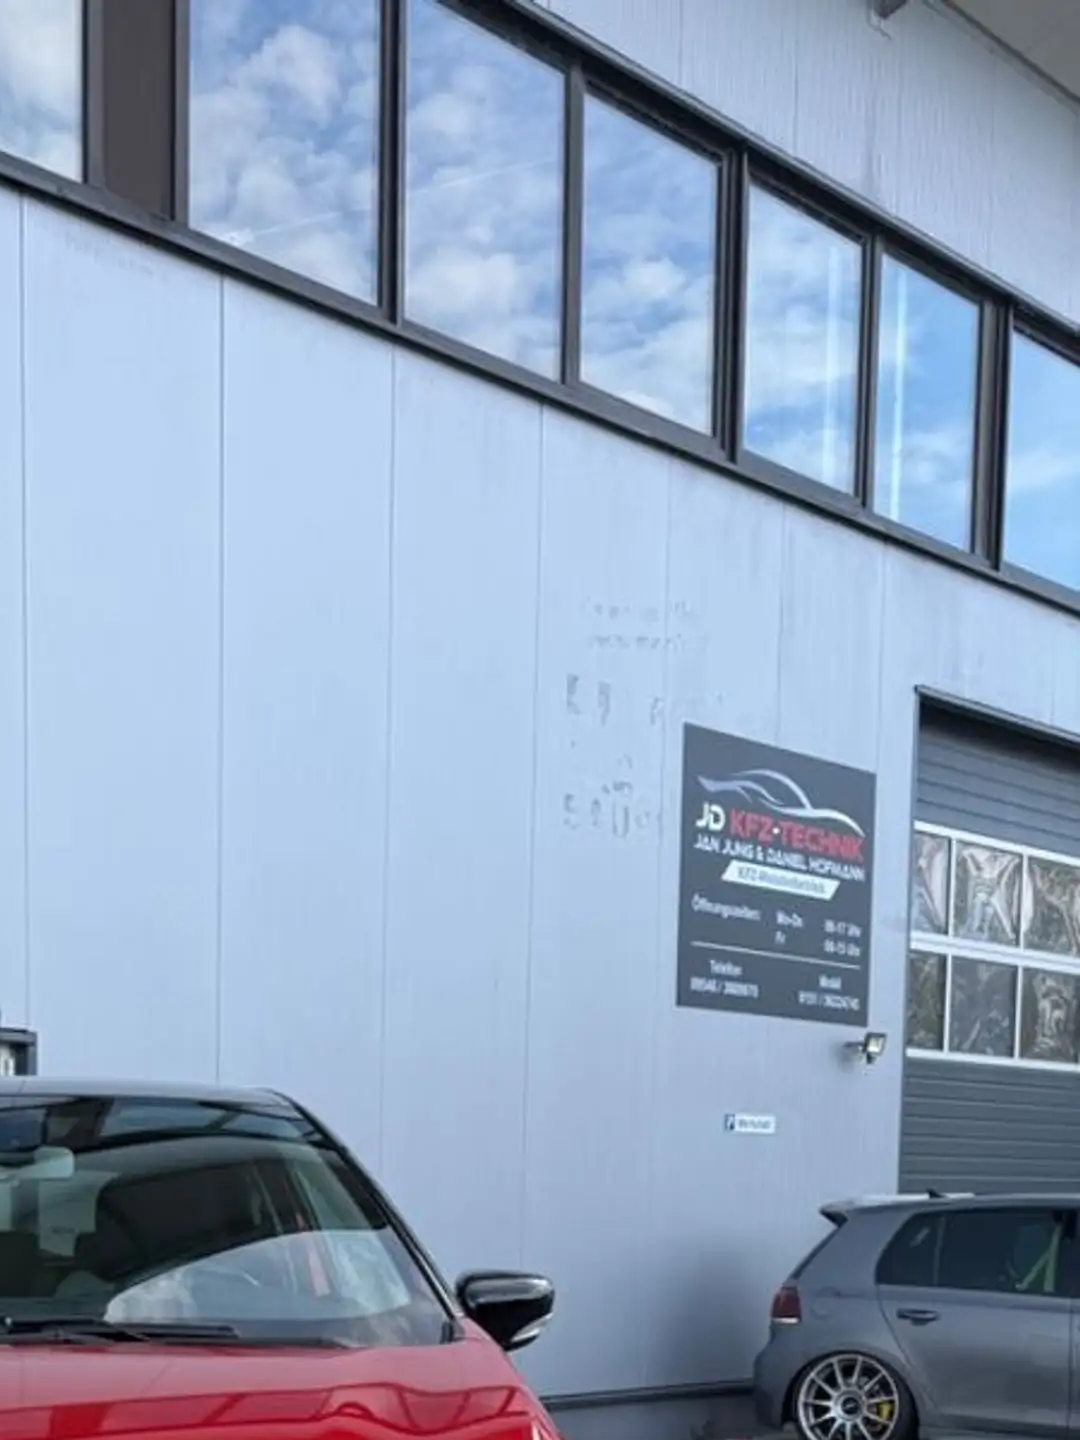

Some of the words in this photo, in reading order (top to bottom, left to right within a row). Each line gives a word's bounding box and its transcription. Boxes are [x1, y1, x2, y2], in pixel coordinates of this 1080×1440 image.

[695, 801, 726, 832] JD
[694, 833, 720, 853] JAN
[722, 838, 754, 860] JUNG
[756, 846, 765, 861] &
[766, 848, 808, 870] DANIEL
